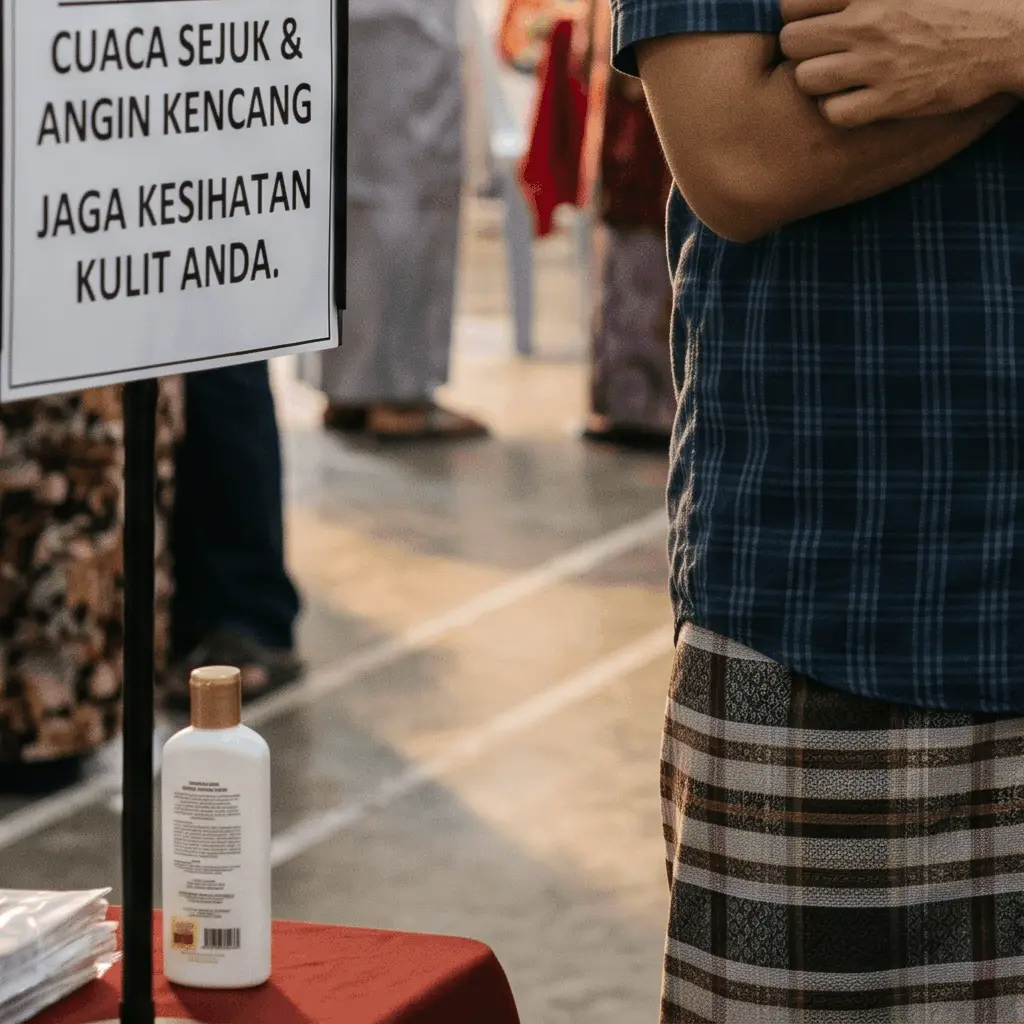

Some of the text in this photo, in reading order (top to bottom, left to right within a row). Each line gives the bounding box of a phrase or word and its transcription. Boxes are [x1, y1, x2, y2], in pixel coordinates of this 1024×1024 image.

[51, 16, 303, 75] CUACA SEJUK &
[36, 82, 313, 146] ANGIN KENCANG
[36, 168, 312, 240] JAGA KESIHATAN
[76, 238, 280, 304] KULIT ANDA.
